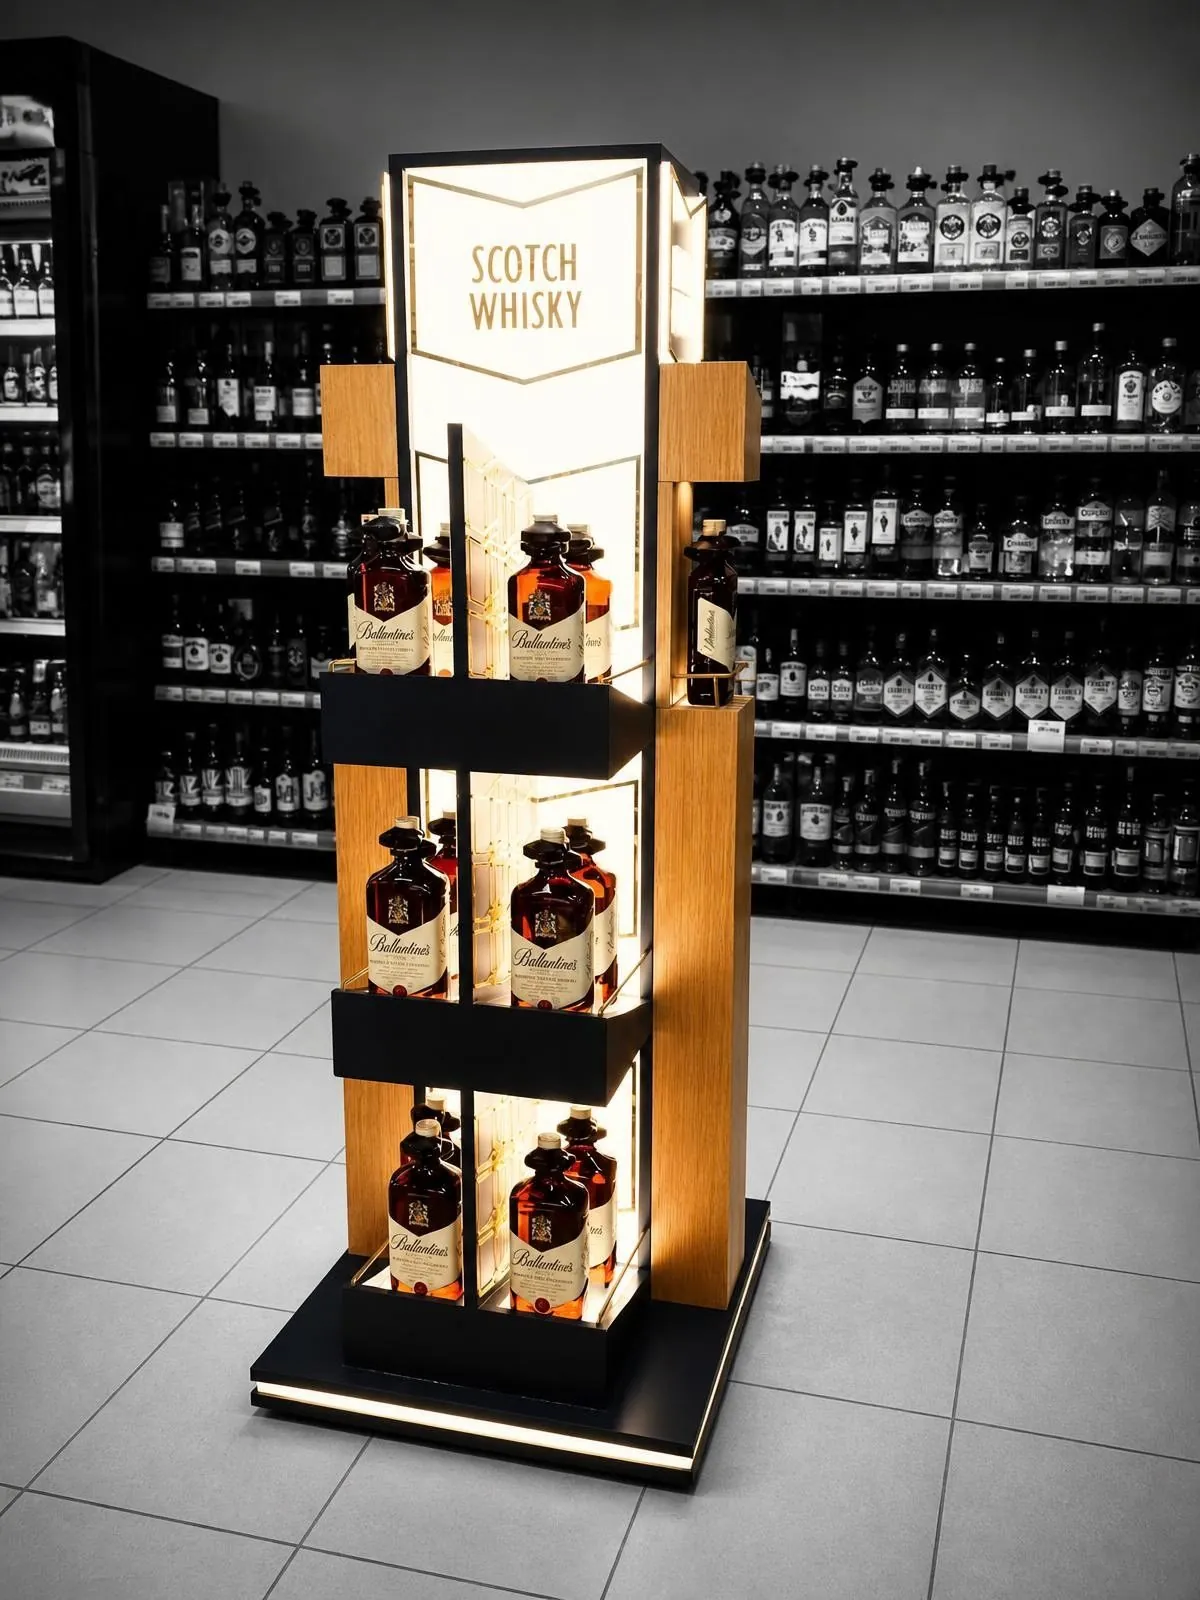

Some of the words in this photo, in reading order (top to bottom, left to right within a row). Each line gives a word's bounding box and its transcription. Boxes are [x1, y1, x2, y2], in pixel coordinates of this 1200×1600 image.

[472, 243, 577, 284] SCOTCH
[469, 291, 582, 331] WHISKY
[356, 620, 415, 641] Ballantine's
[511, 629, 571, 650] Ballantine's
[369, 932, 431, 956] Ballantine's
[513, 947, 577, 971] Ballantine's
[390, 1233, 449, 1256] Ballantine's
[511, 1248, 573, 1273] Ballantine's
